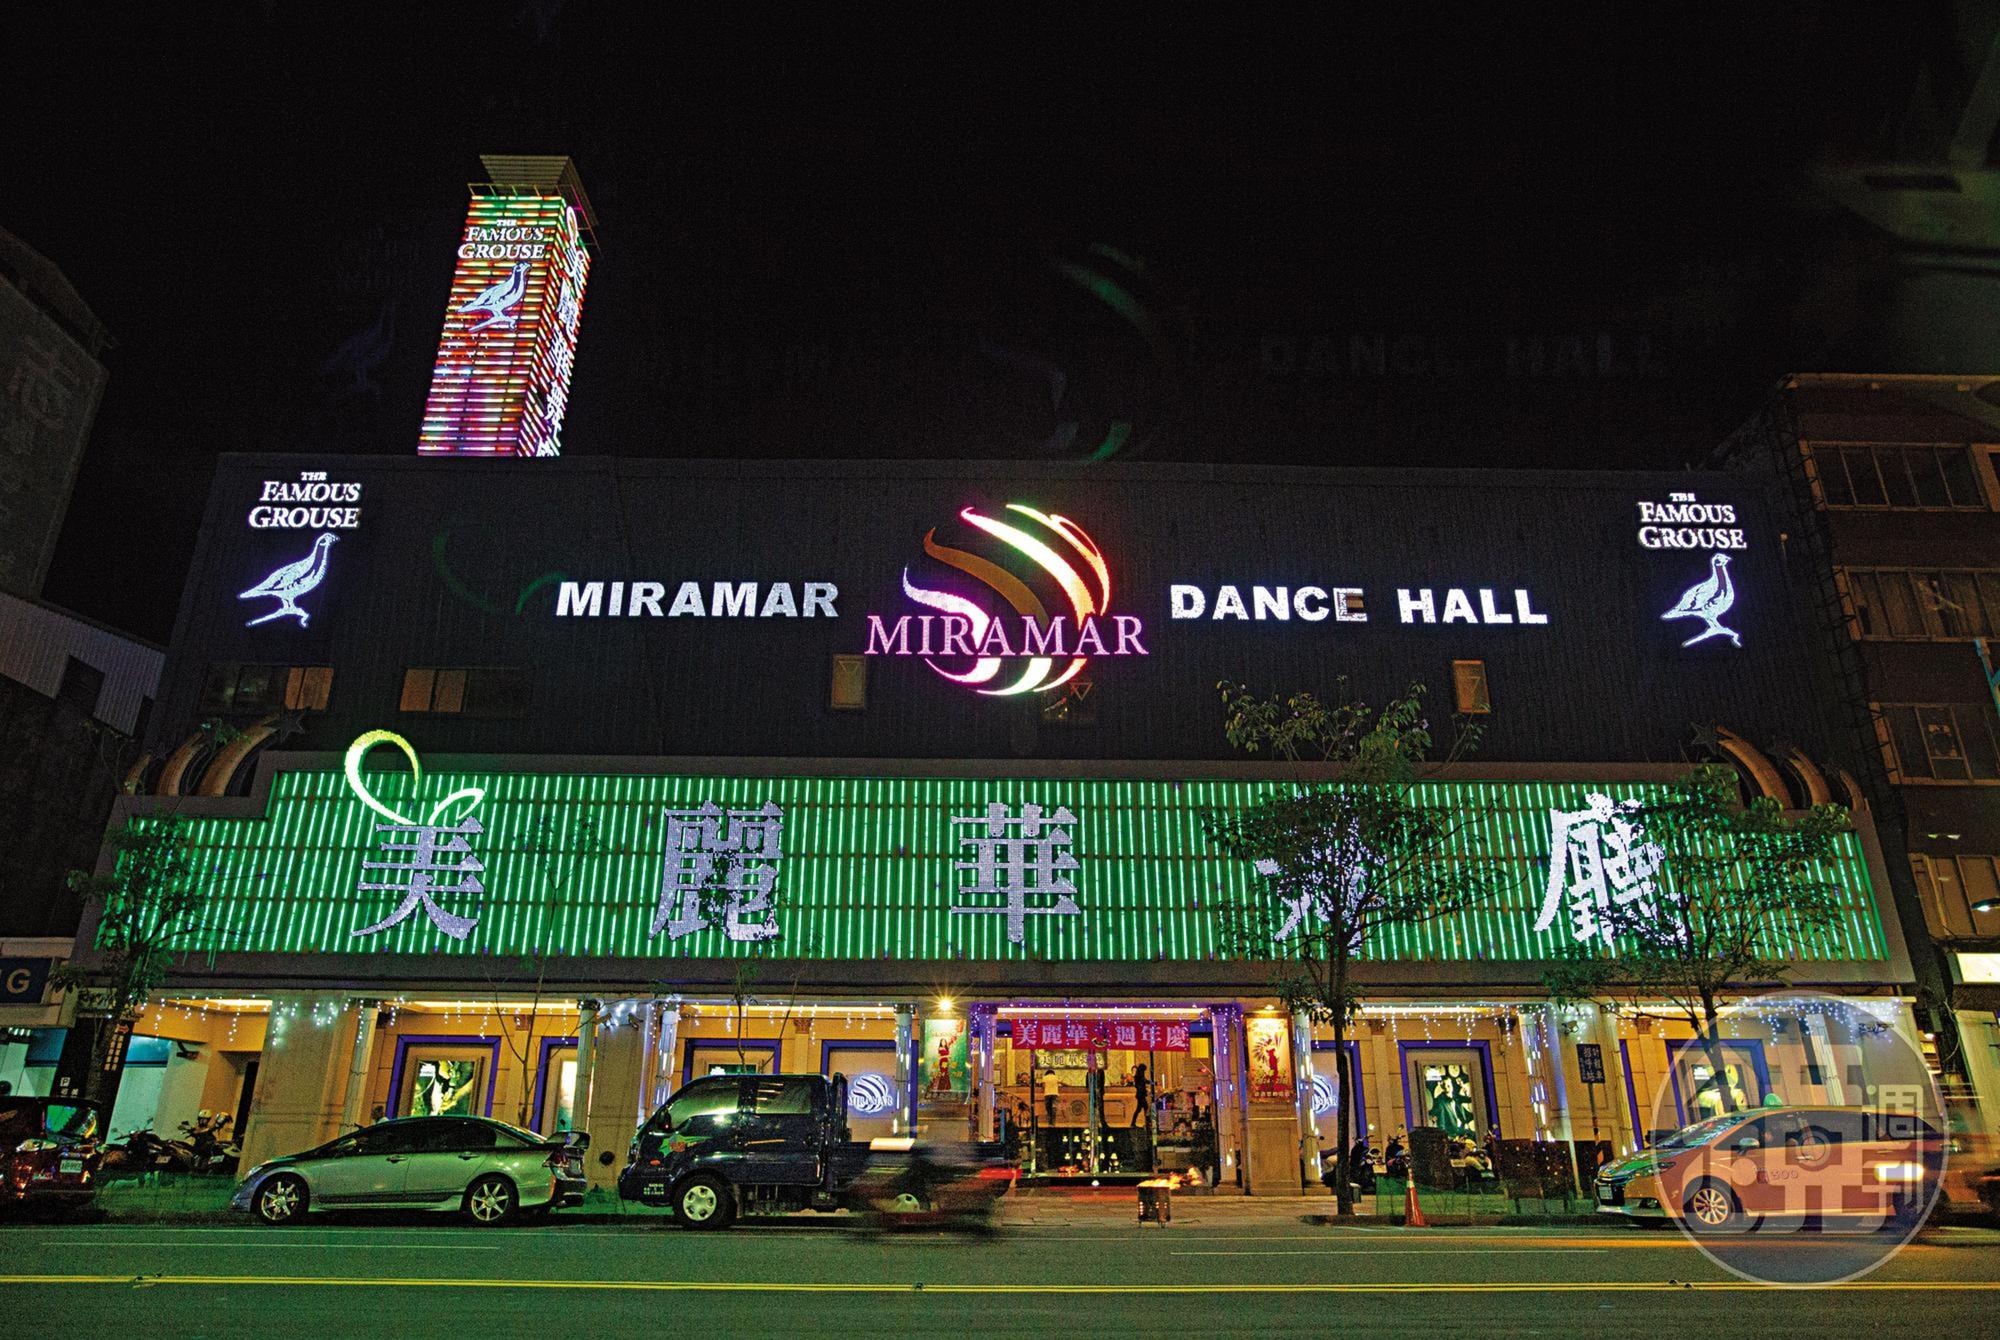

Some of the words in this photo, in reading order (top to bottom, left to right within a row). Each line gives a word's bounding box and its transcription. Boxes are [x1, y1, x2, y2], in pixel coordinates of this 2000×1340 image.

[465, 226, 545, 242] FAMOUS
[457, 243, 545, 259] GROUSE
[300, 471, 327, 481] THE
[259, 481, 361, 502] FAMOUS
[248, 506, 359, 528] GROUSE
[1637, 501, 1736, 523] FAMOUS
[1638, 526, 1748, 549] GROUSE
[555, 581, 839, 618] MIRAMAR
[1170, 584, 1368, 624] DANCE
[1397, 588, 1549, 625] HALL
[864, 613, 1150, 657] MIRAMAR
[0, 968, 32, 994] G
[1016, 1022, 1190, 1048] 美麗華週年慶
